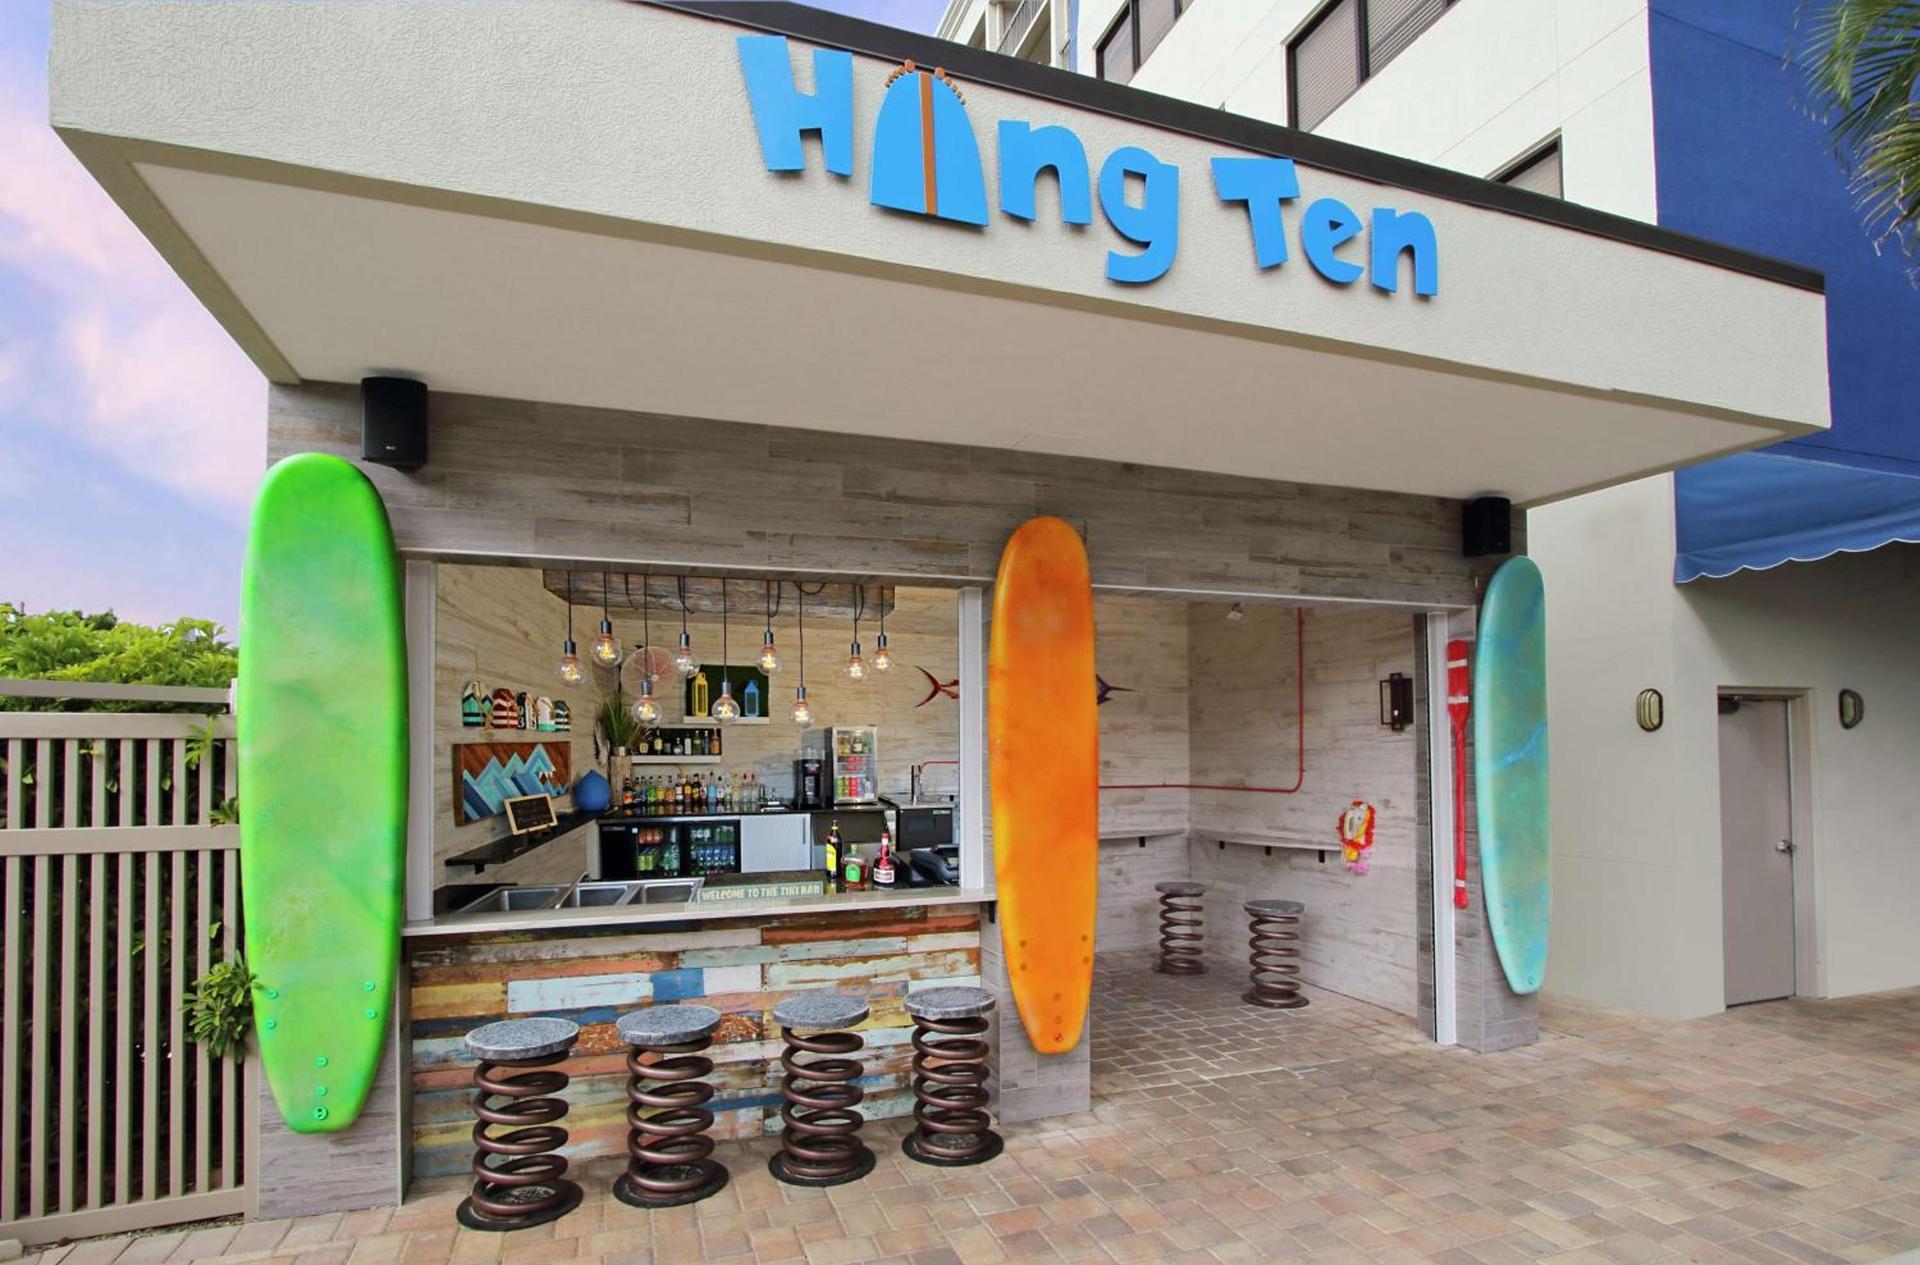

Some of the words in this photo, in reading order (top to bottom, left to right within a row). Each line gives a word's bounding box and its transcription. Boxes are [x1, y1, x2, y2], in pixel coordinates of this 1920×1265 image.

[1210, 156, 1438, 296] Ten
[701, 888, 746, 901] WELCOME
[748, 888, 760, 898] TO
[761, 887, 778, 897] THE
[800, 884, 820, 895] BAR
